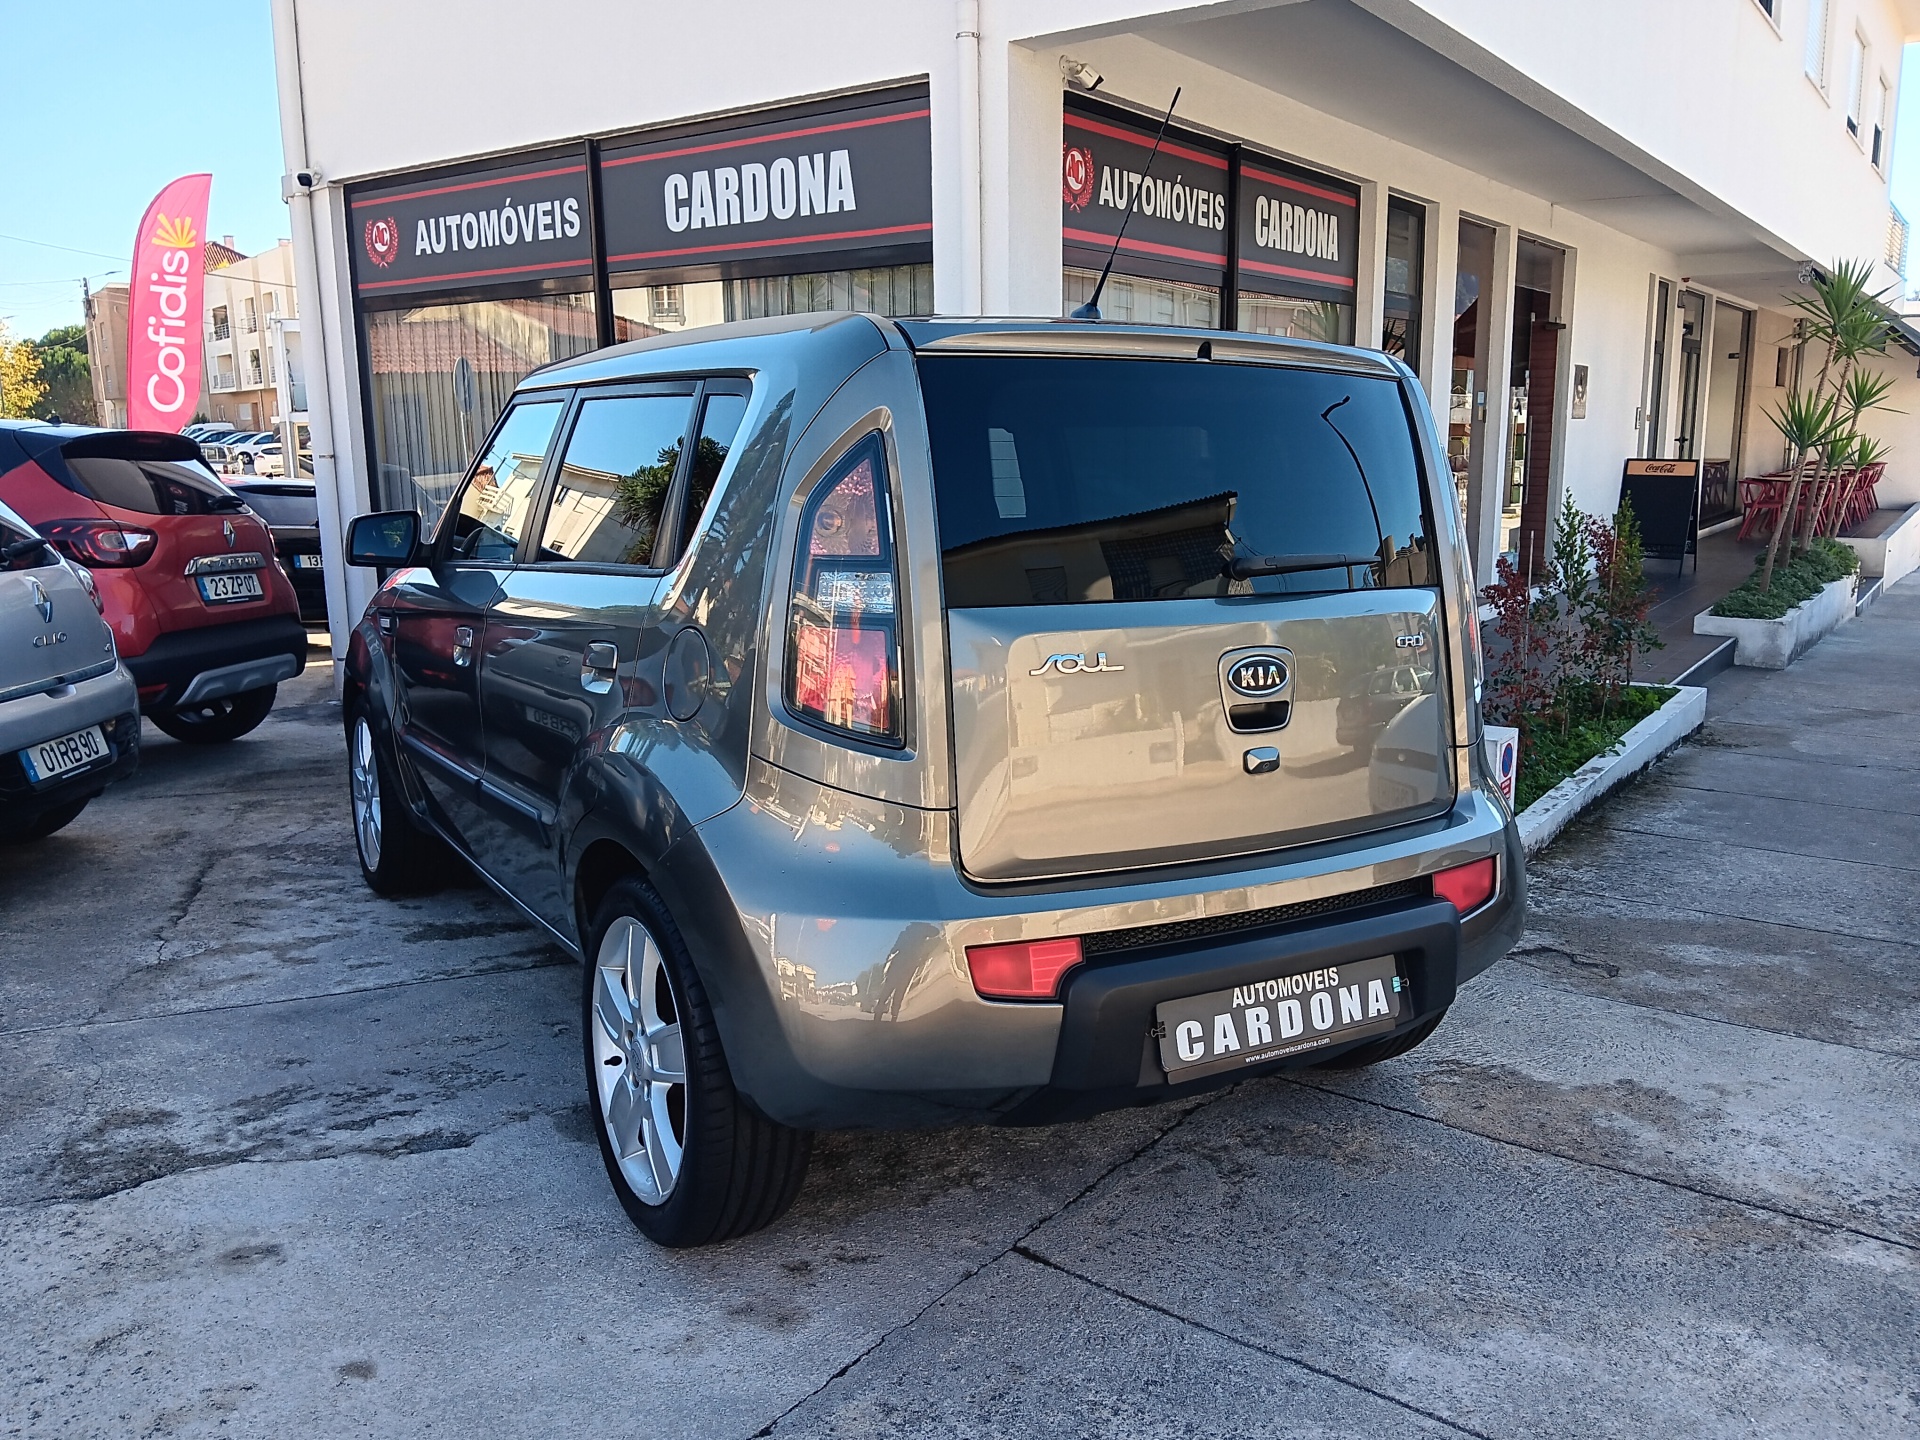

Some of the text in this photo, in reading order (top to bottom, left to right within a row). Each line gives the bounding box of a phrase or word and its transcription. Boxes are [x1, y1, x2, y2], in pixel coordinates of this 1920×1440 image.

[415, 150, 857, 257] AUTOMÓVEIS CARDONA
[1099, 165, 1338, 261] AUTOMÓVEIS CARDONA
[147, 250, 189, 413] Cofidis
[33, 632, 67, 648] CLIO
[1029, 652, 1125, 676] SOUL
[1240, 665, 1281, 688] KIA
[40, 731, 99, 773] 01RB90
[1232, 966, 1340, 1009] AUTOMOVEIS
[1175, 978, 1390, 1062] CARDONA
[1245, 1037, 1331, 1064] www.automoveiscardona.com
